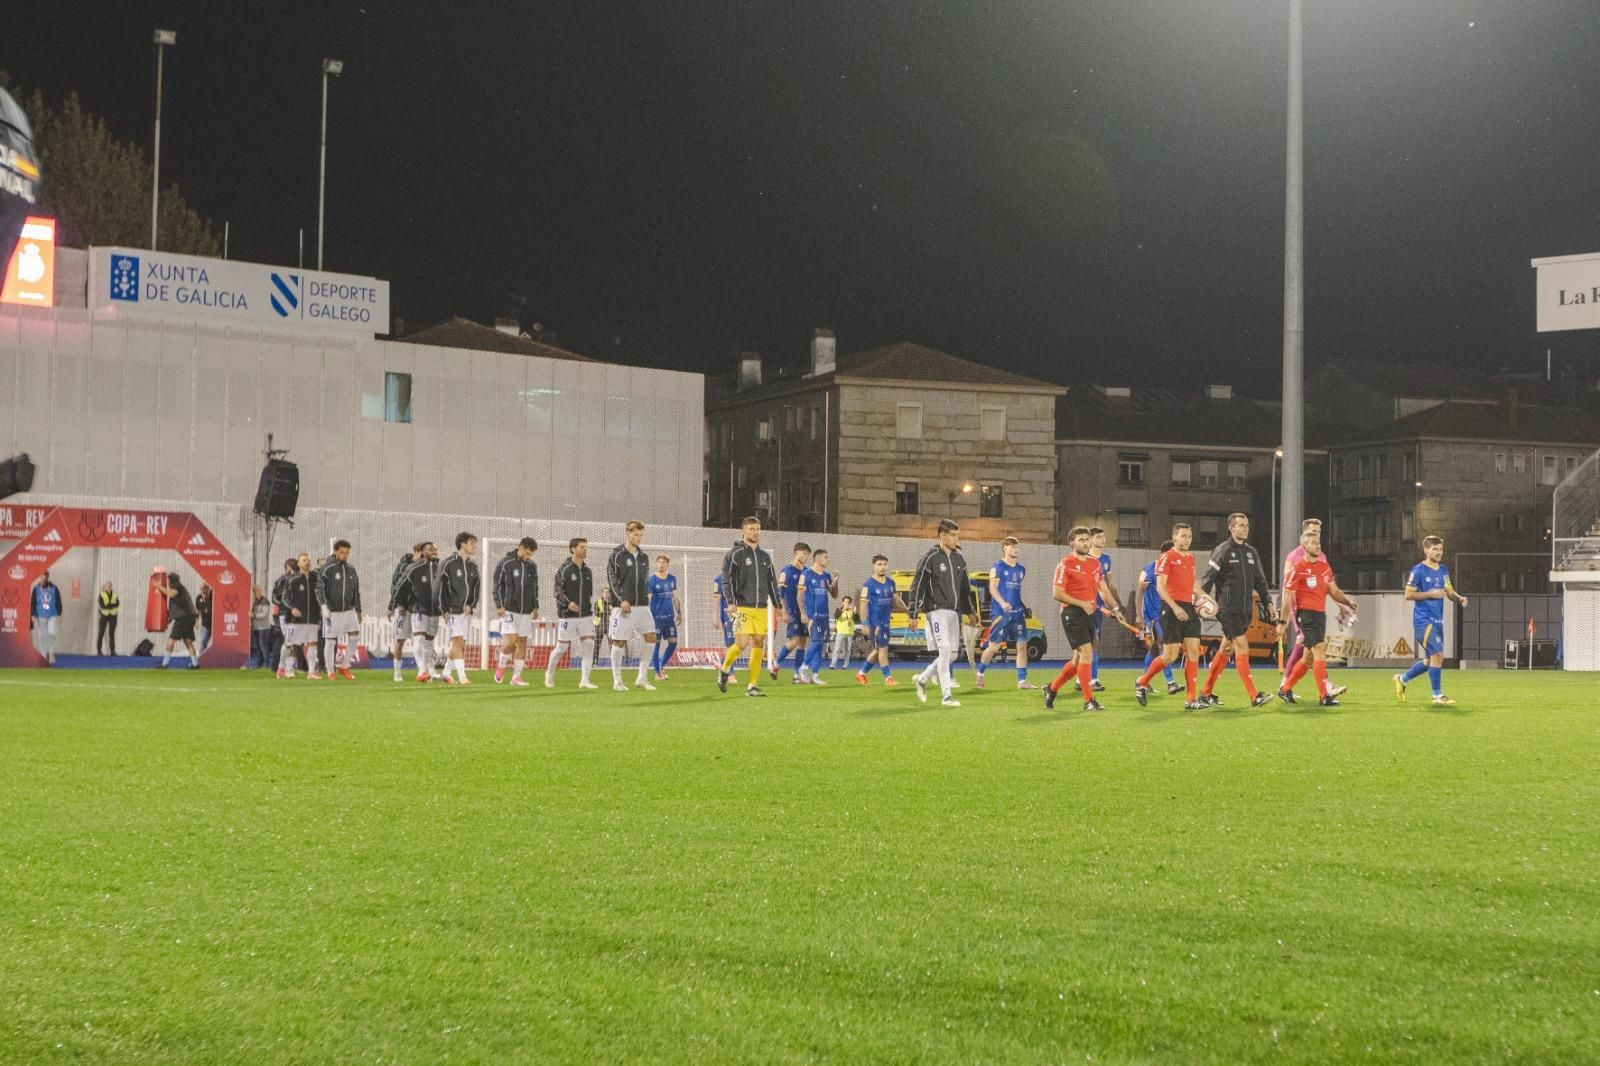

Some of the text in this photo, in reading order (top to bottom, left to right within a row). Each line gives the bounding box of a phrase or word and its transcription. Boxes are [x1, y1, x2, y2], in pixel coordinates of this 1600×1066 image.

[147, 262, 209, 285] XUNTA
[146, 283, 248, 310] DE GALICIA
[310, 281, 376, 303] DEPORTE
[1559, 289, 1585, 306] La
[309, 303, 370, 323] GALEGO
[107, 513, 168, 535] COPA REY
[612, 618, 618, 628] 3
[934, 622, 940, 633] 8
